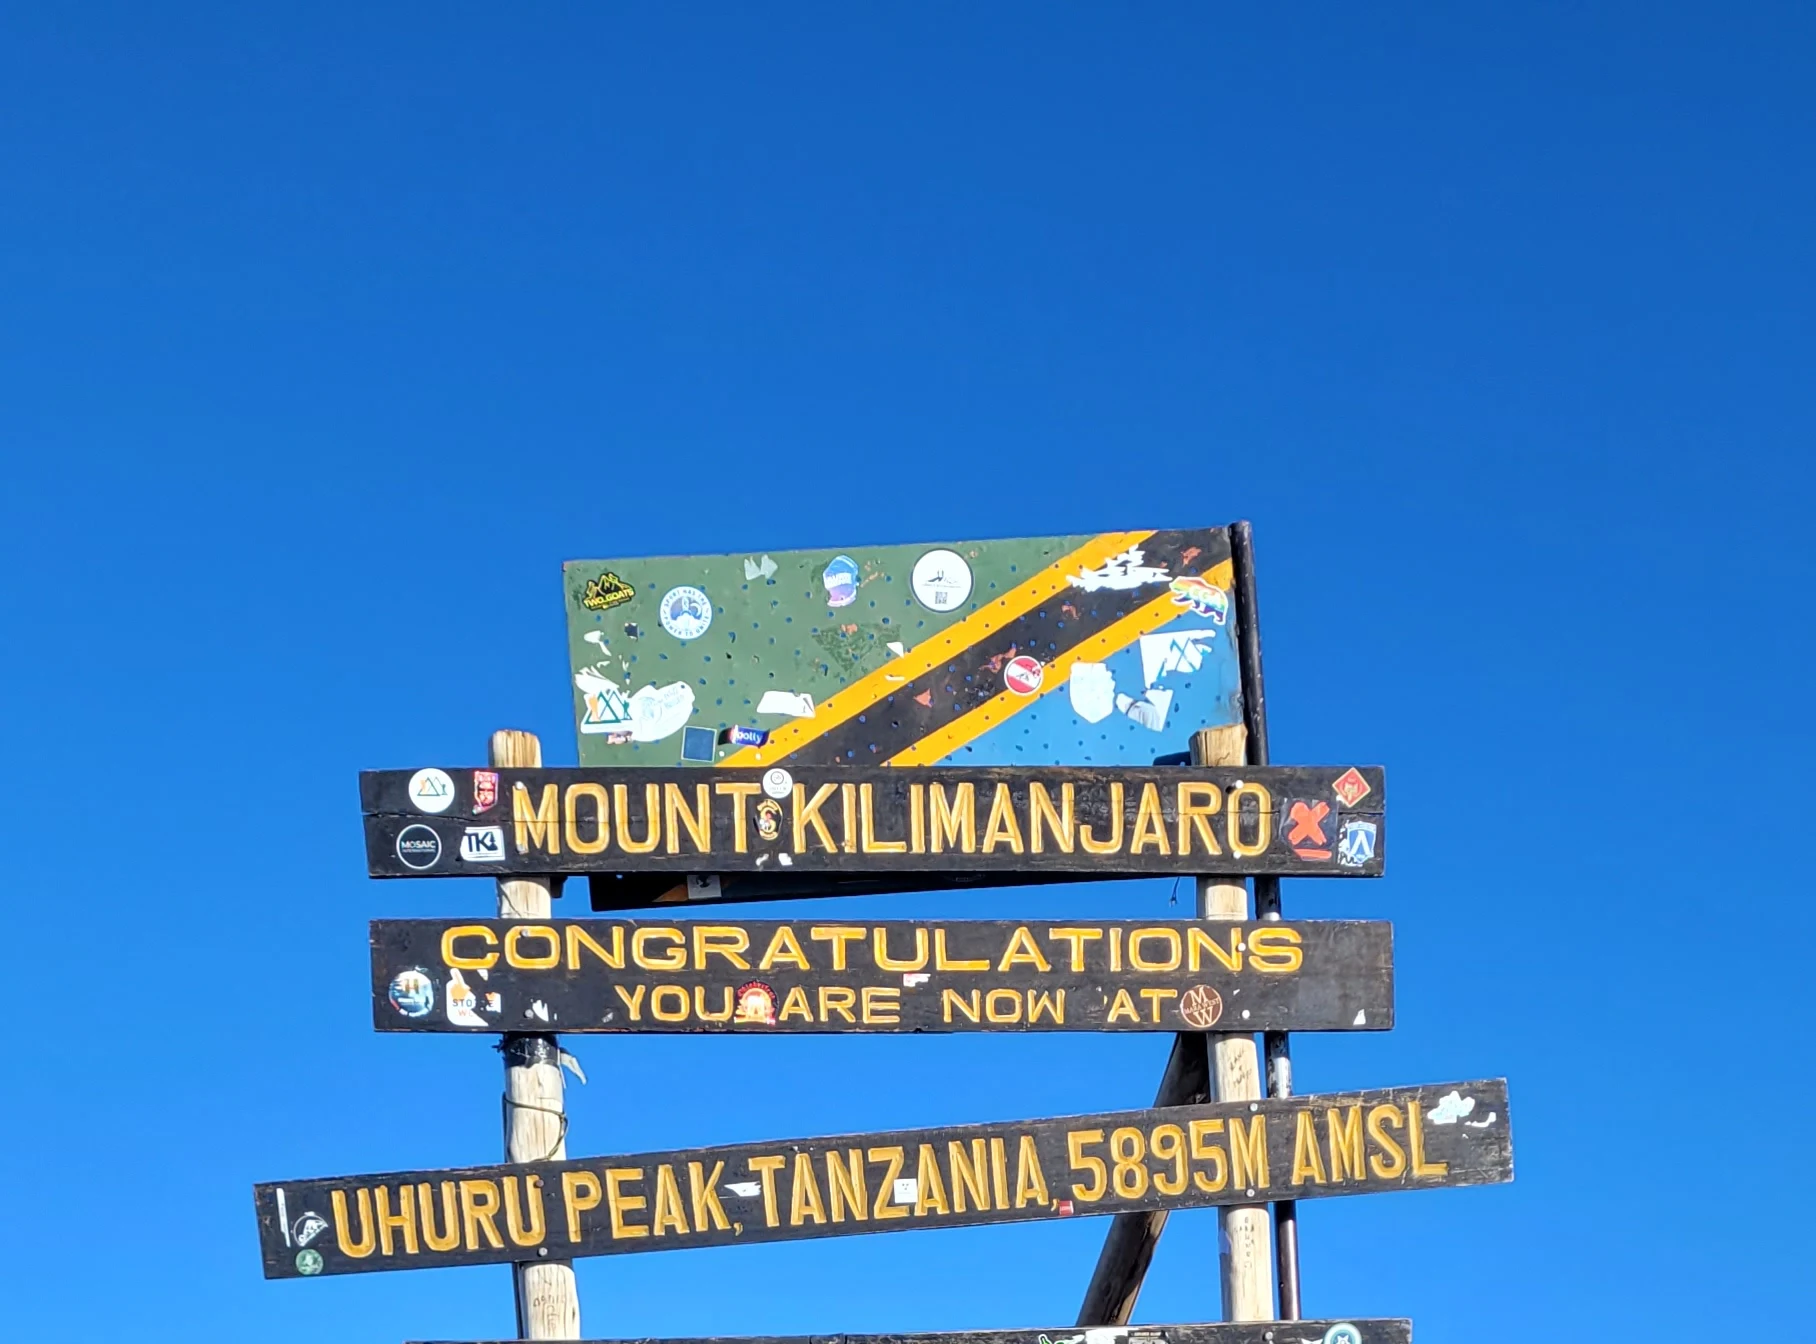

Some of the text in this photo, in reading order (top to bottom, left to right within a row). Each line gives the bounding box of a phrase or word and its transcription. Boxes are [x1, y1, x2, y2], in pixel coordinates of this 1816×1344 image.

[514, 783, 760, 854] MOUNT
[793, 782, 1271, 855] KILIMANJARO
[401, 841, 436, 849] MOSAIC
[442, 925, 1303, 973] CONGRATULATIONS
[616, 985, 1178, 1025] YOU ARE NOW AT
[333, 1100, 1448, 1257] UHURU PEAK, TANZANIA, 5895M AMSL
